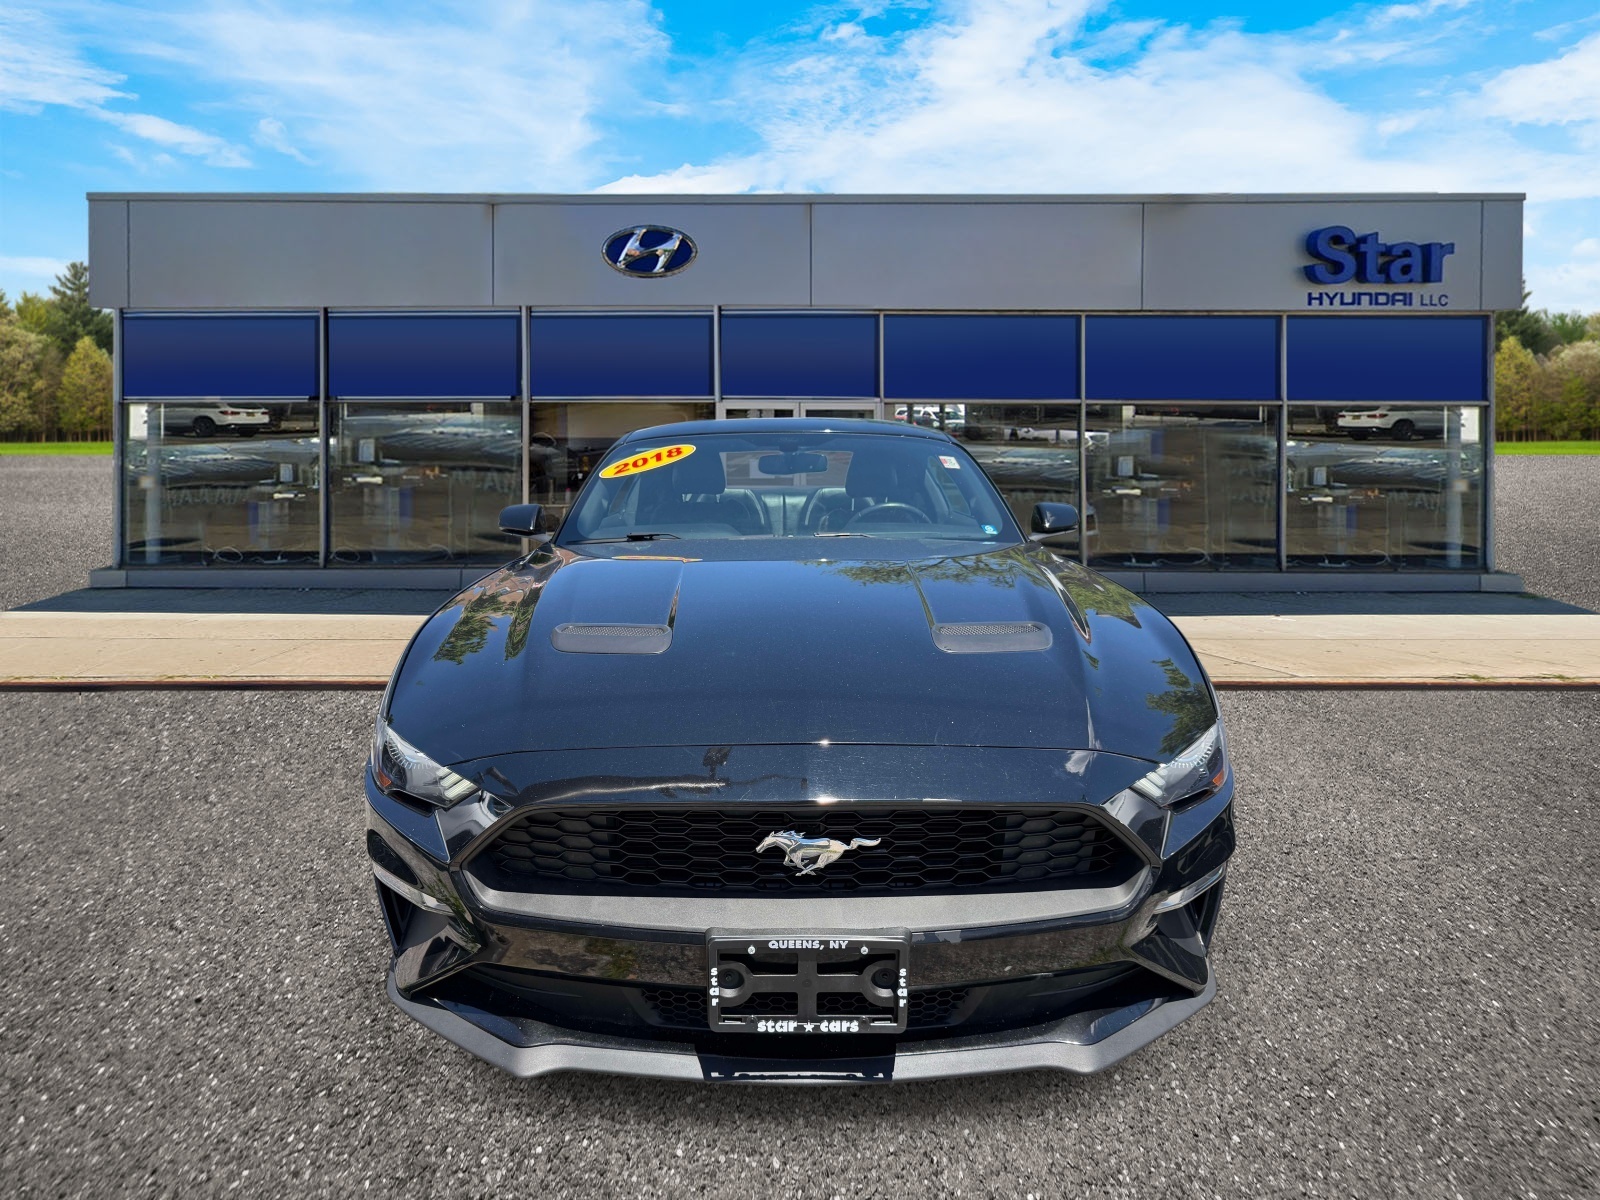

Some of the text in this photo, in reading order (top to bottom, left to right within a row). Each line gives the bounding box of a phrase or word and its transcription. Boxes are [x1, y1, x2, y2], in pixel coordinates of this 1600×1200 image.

[1303, 225, 1454, 284] Star
[1307, 292, 1449, 307] HYUNDAI LLC
[613, 447, 683, 475] 2018
[768, 940, 848, 950] QUEENS, NY
[709, 967, 719, 1006] star
[897, 968, 907, 1007] star
[757, 1019, 859, 1032] star cars
